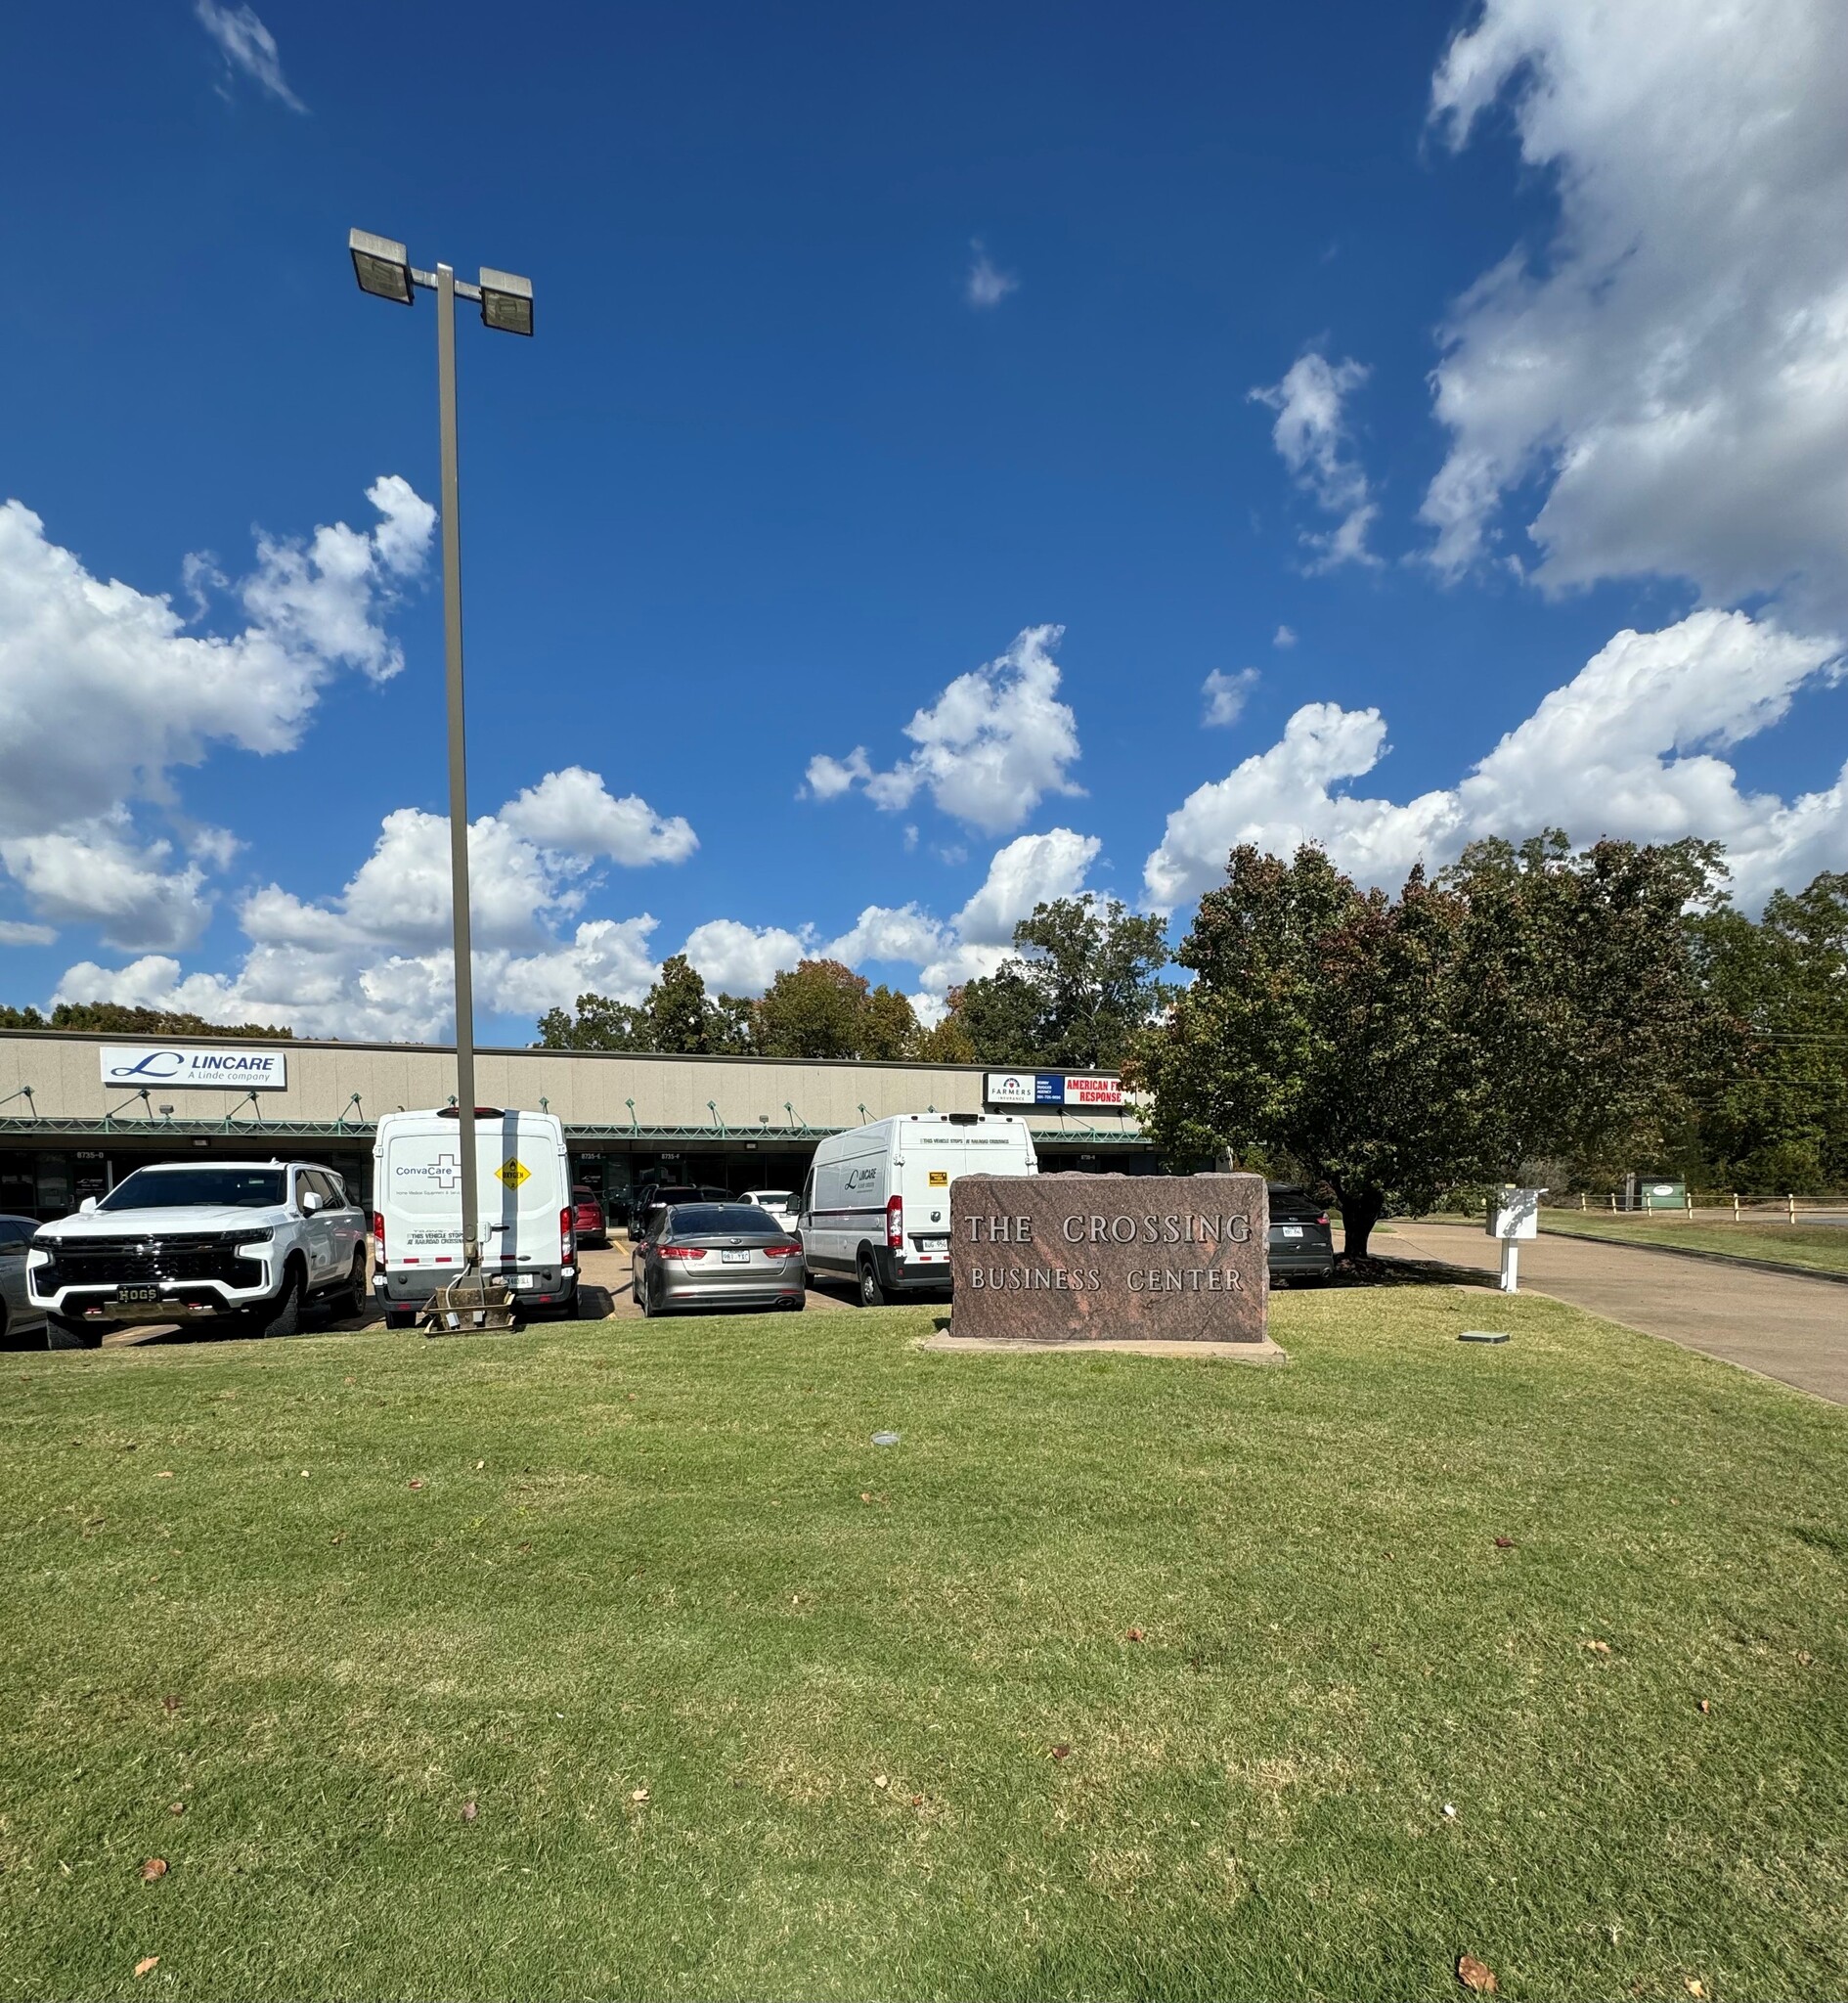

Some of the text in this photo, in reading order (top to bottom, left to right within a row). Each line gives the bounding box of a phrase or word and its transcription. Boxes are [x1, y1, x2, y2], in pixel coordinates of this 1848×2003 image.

[192, 1055, 275, 1071] LINCARE
[198, 1071, 225, 1080] Linde
[227, 1073, 271, 1082] company
[1067, 1080, 1109, 1091] AMERICAN
[991, 1088, 1032, 1096] FARMERS
[1079, 1091, 1122, 1102] RESPONSE
[396, 1167, 453, 1176] ConvaCare
[964, 1214, 1253, 1244] THE CROSSING
[971, 1268, 1243, 1292] BUSINESS CENTER
[119, 1289, 156, 1300] HOGS
